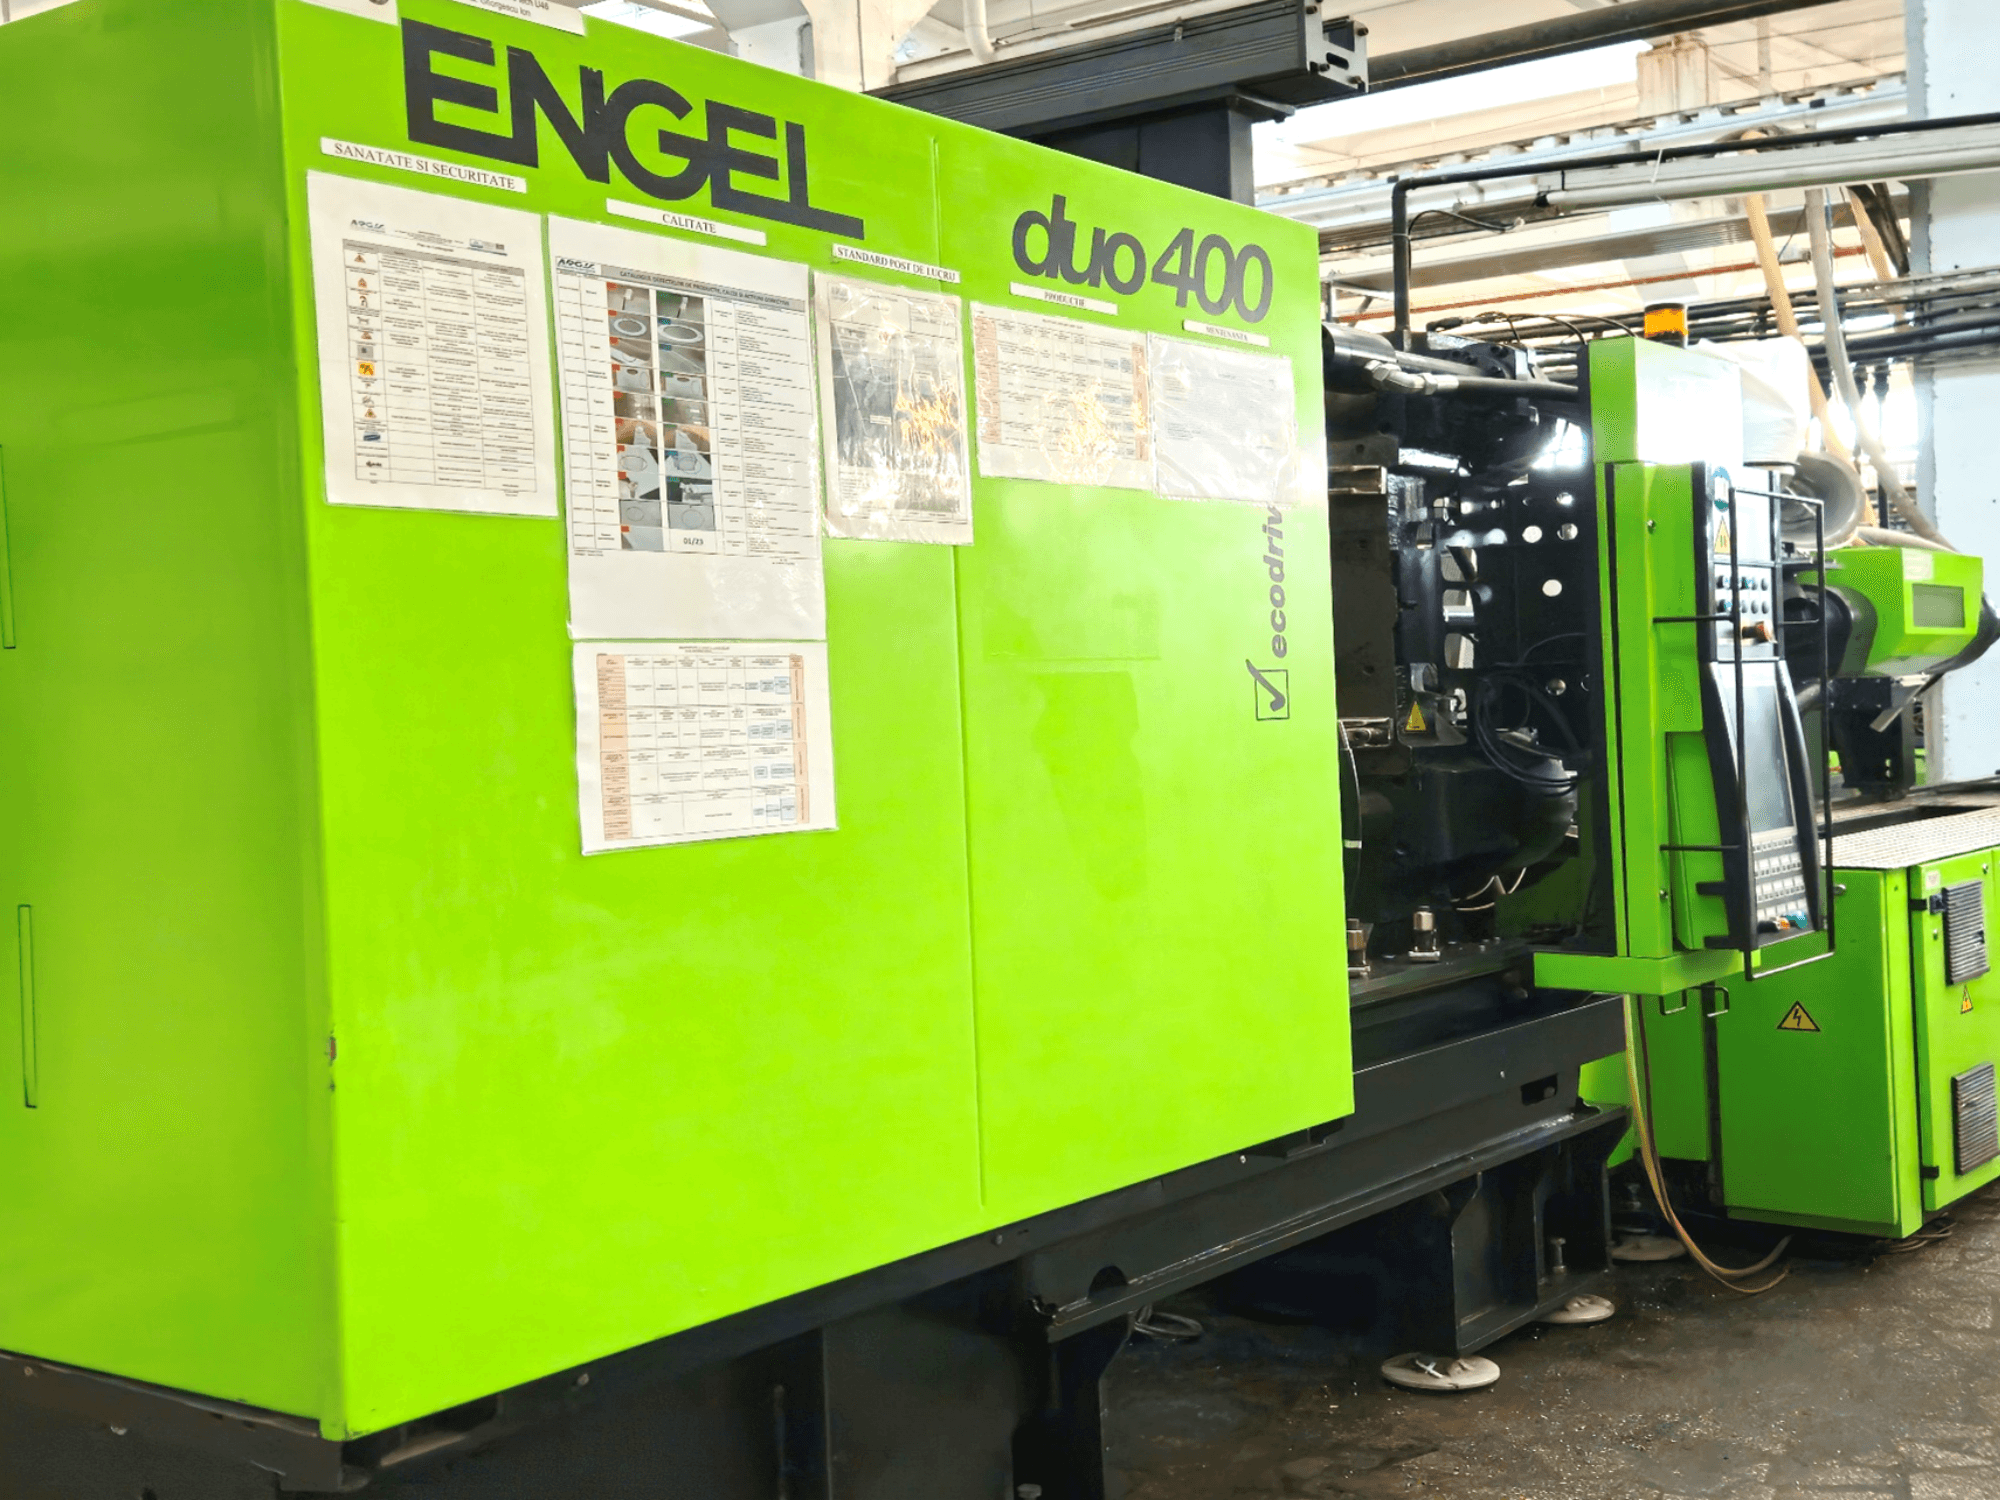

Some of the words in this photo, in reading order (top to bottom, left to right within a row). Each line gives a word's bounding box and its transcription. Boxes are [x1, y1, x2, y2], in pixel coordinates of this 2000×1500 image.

[401, 17, 864, 240] ENGEL
[334, 141, 414, 169] SANATATE
[416, 159, 430, 172] SI
[432, 163, 517, 190] SECURITATE
[662, 213, 717, 234] CALITATE
[837, 246, 889, 267] STANDARD
[889, 259, 912, 272] POST
[912, 263, 926, 275] DE
[926, 266, 956, 281] LUCRU
[1261, 502, 1288, 659] ecodriv
